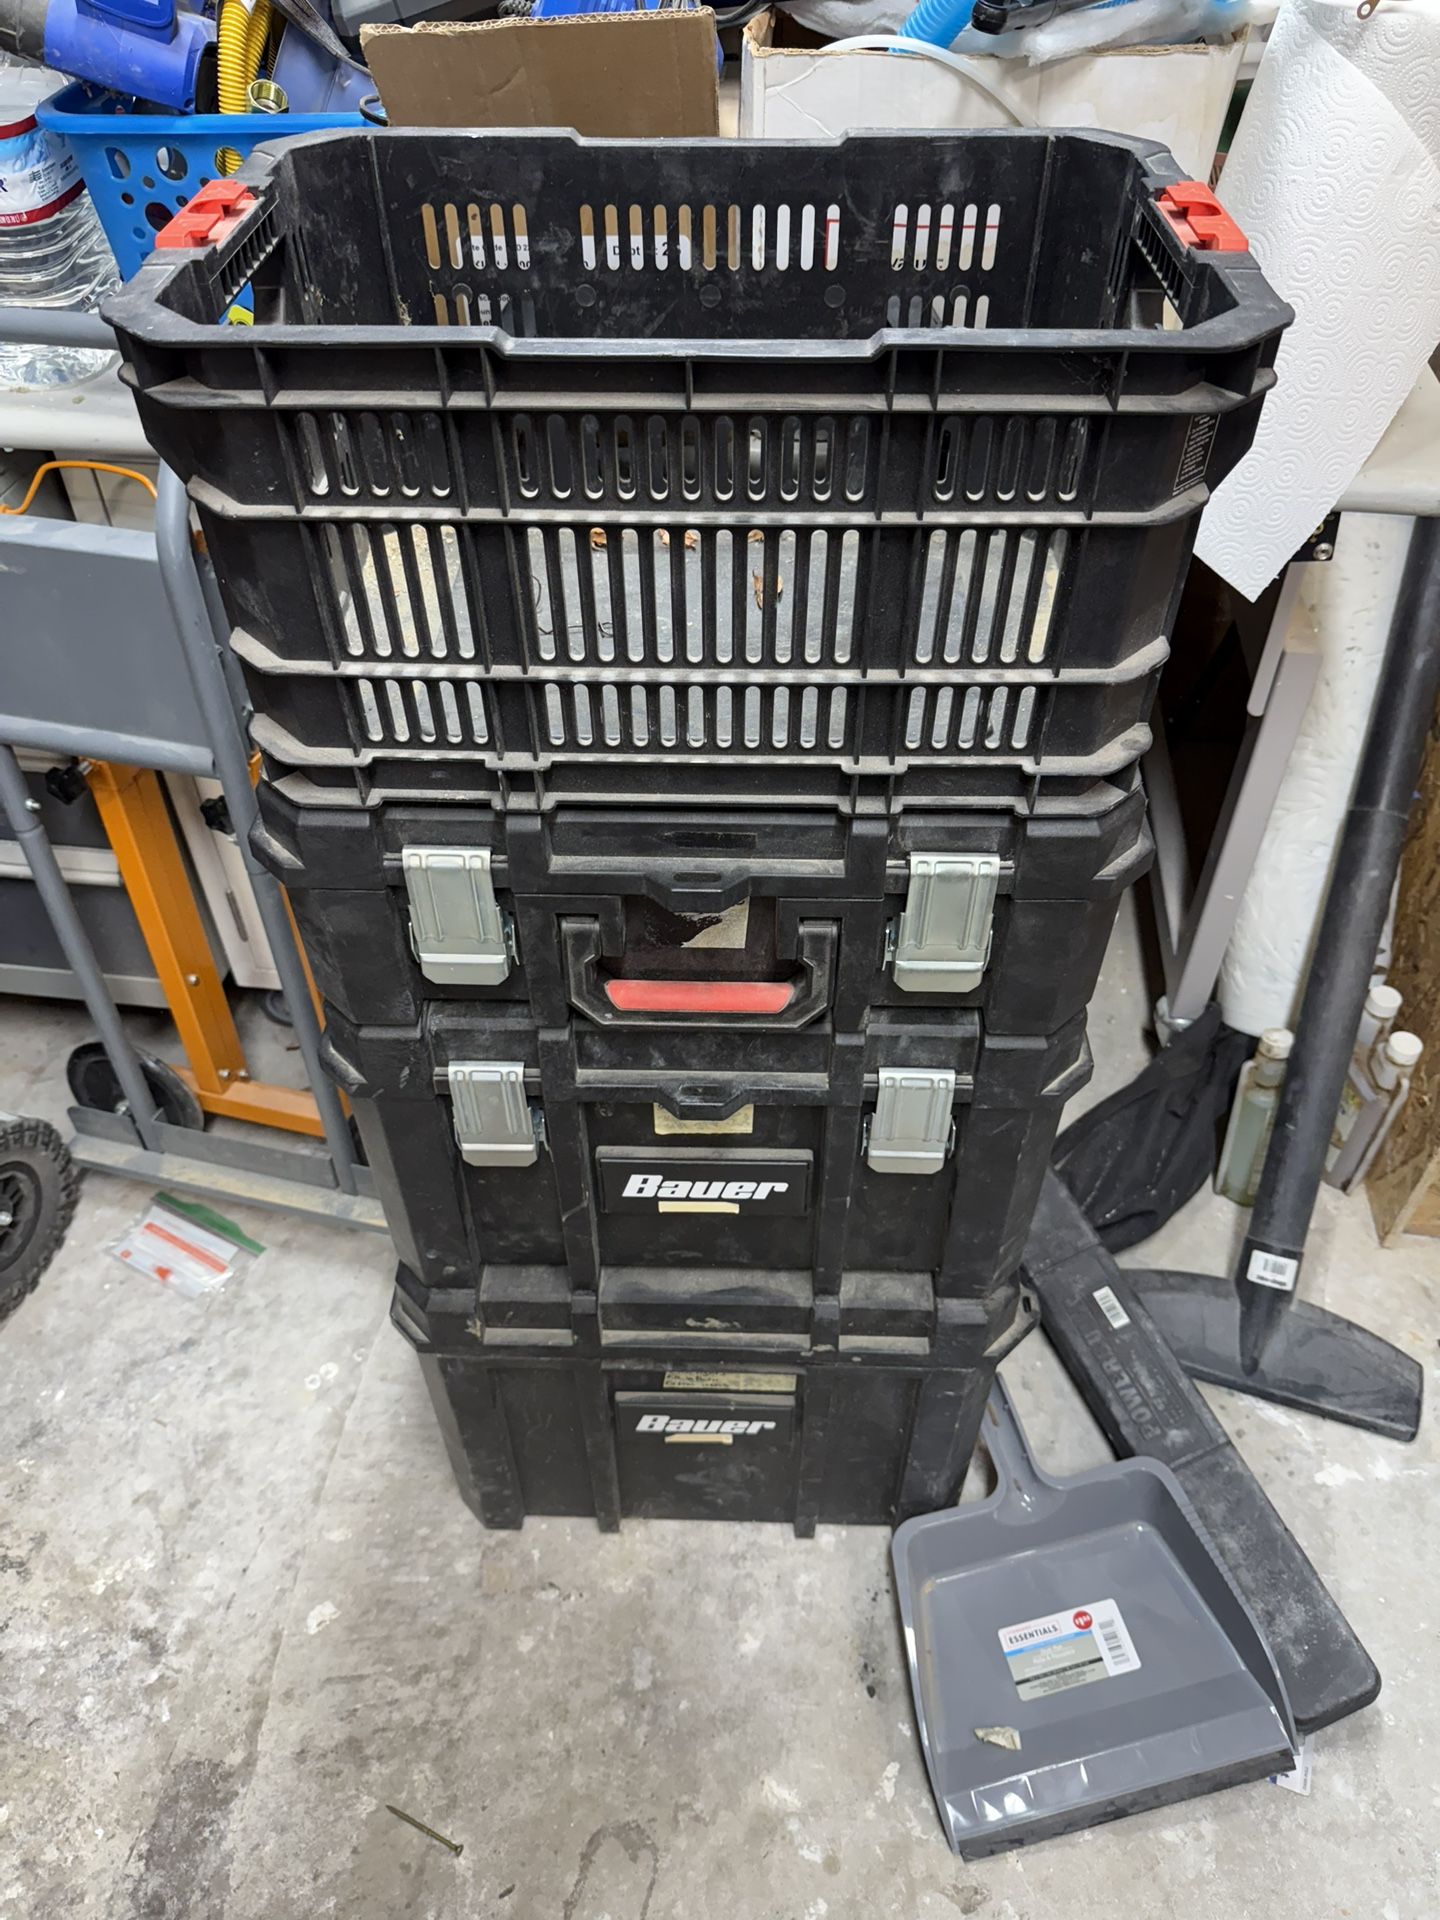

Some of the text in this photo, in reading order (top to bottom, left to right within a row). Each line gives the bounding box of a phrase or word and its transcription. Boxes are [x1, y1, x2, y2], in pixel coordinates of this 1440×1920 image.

[622, 1174, 790, 1200] Bauer
[635, 1415, 776, 1435] Bauer
[1008, 1625, 1058, 1644] ESSENTIALS
